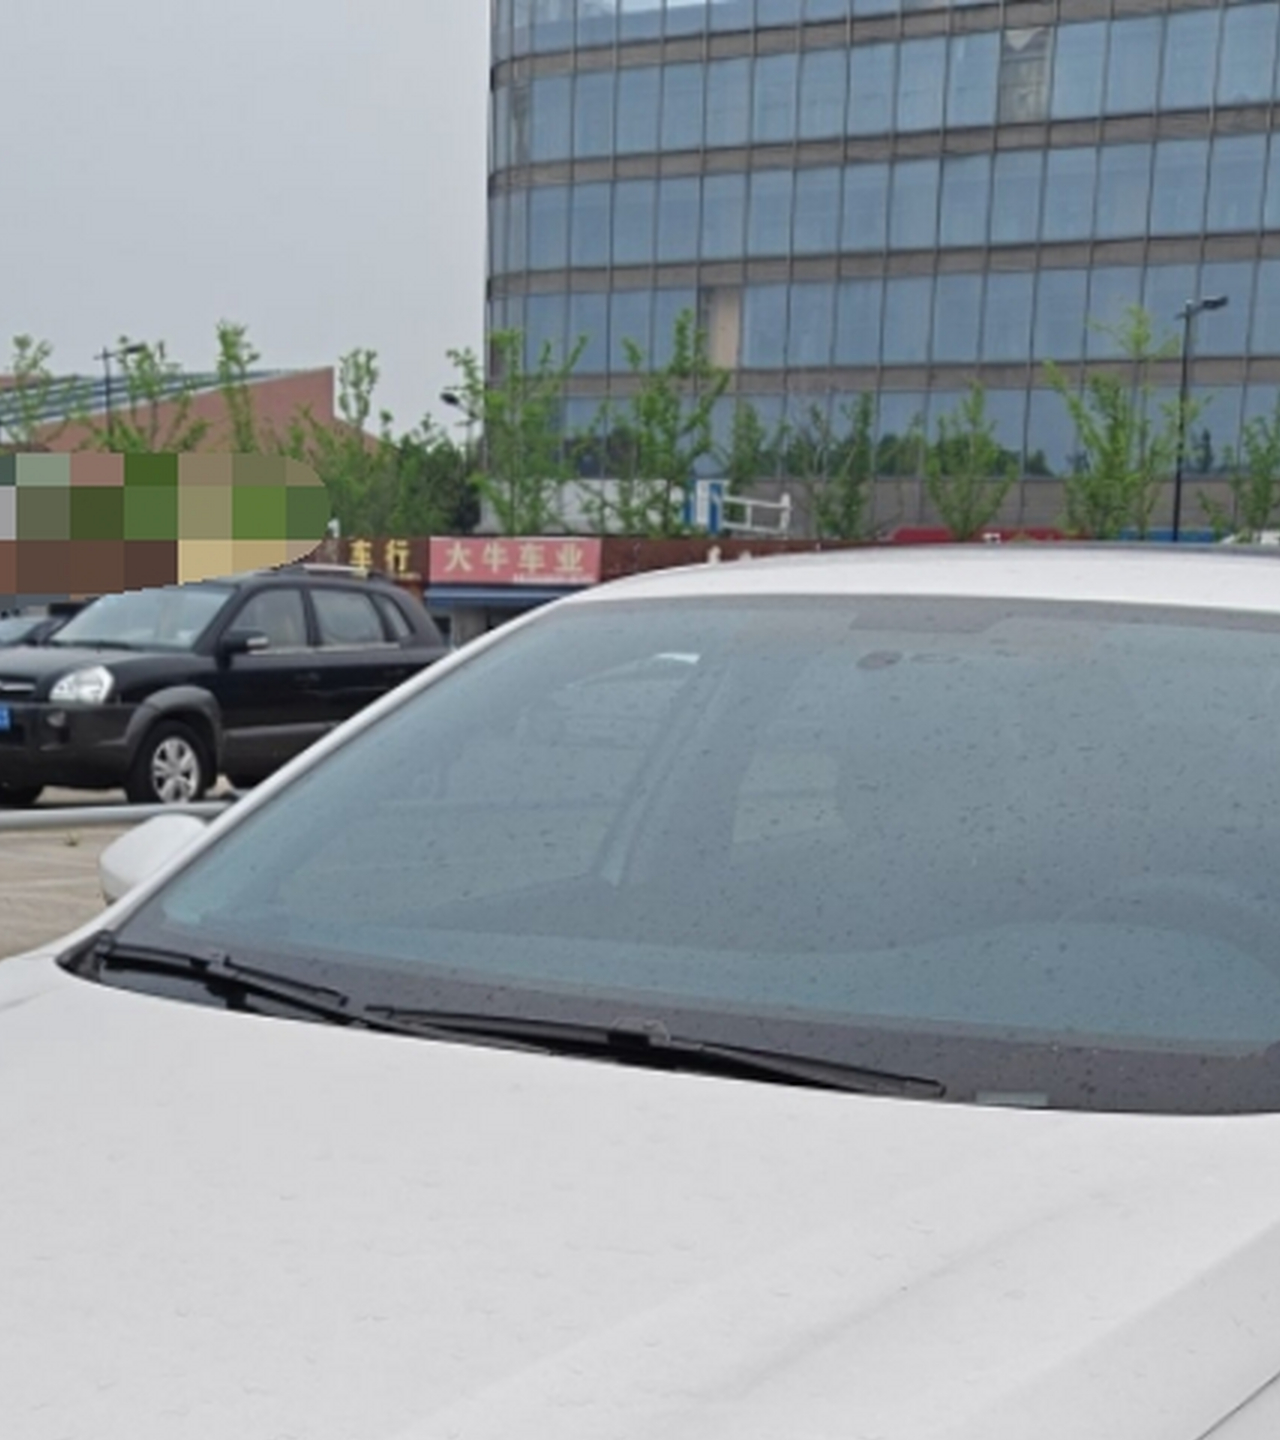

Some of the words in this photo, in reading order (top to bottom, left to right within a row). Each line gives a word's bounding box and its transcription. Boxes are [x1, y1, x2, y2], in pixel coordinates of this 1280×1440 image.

[349, 538, 411, 572] 车行
[444, 540, 585, 574] 大牛车业
